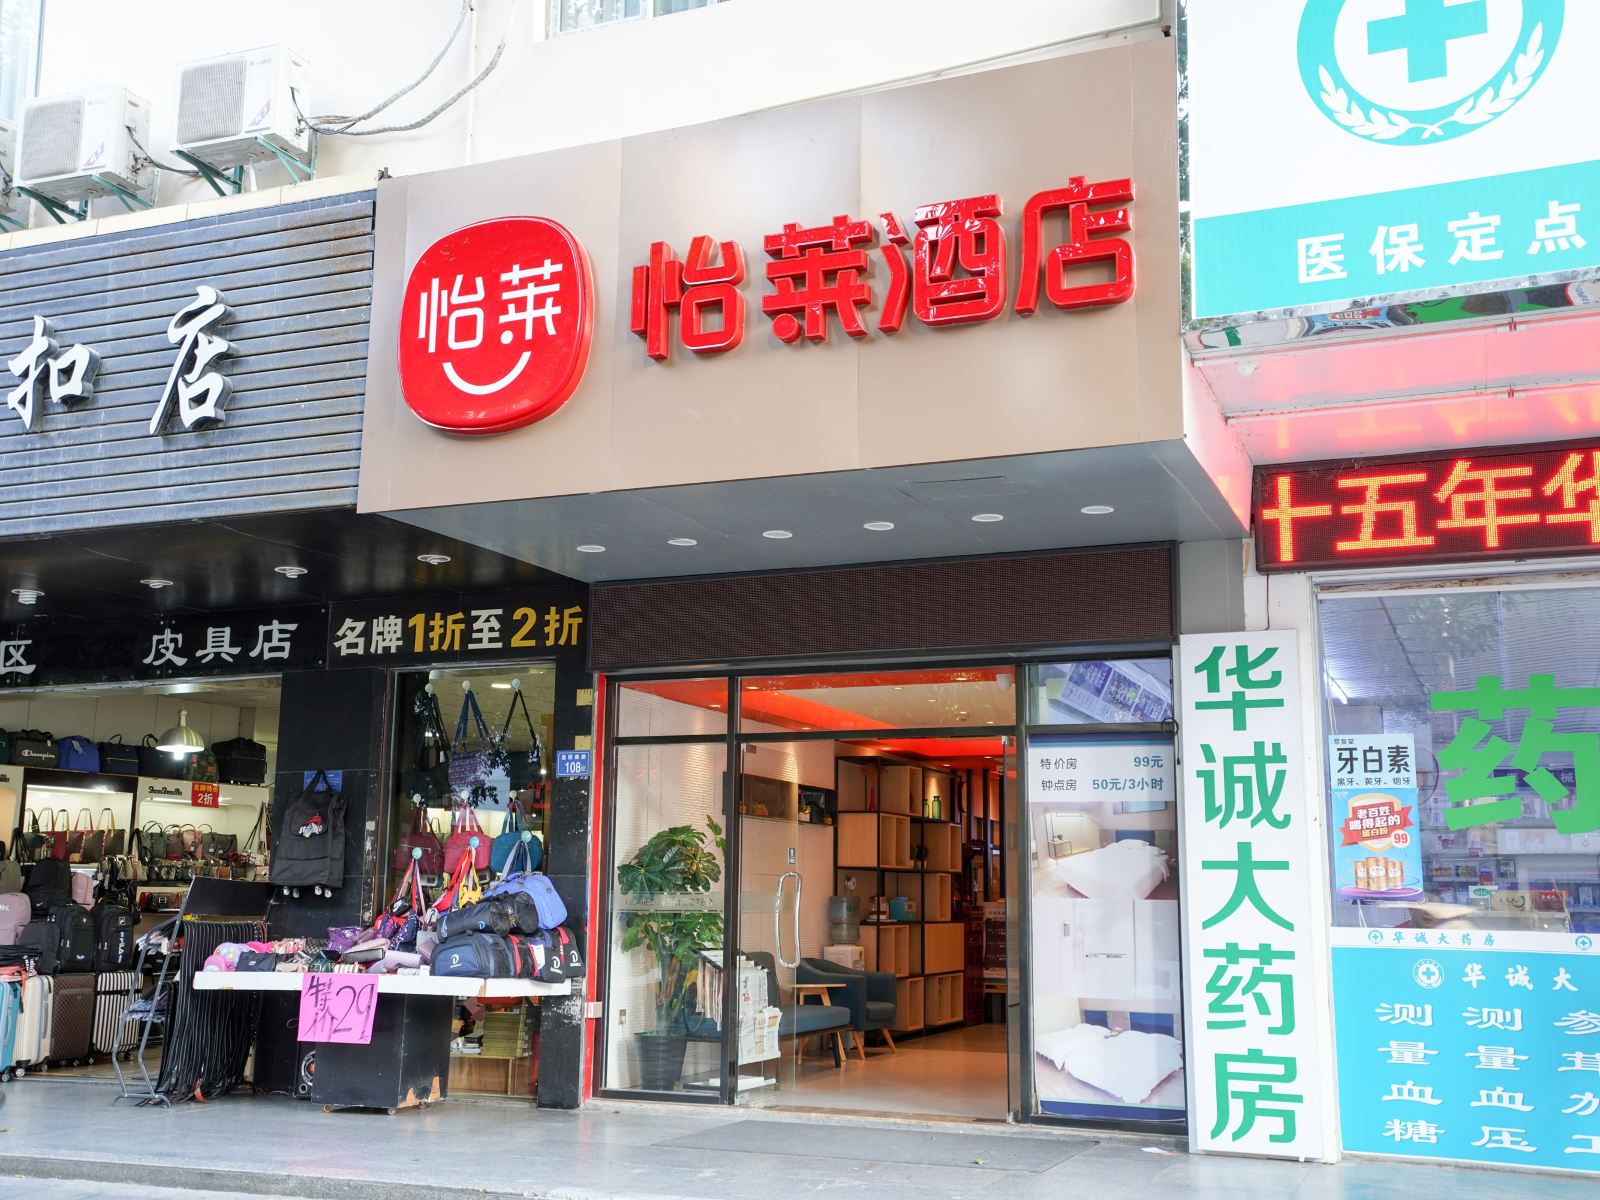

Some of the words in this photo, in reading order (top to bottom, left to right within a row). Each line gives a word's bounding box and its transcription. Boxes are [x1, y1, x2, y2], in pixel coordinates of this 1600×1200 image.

[1296, 199, 1588, 285] 医保定点
[630, 175, 1136, 361] 怡莱酒店
[418, 258, 563, 353] 怡莱
[7, 285, 238, 436] 扣店
[142, 619, 298, 667] 皮具店
[333, 605, 584, 656] 名牌1折至2折
[1040, 758, 1078, 770] 特价房
[1134, 756, 1164, 768] 99元
[1336, 744, 1410, 775] 牙白素
[1431, 674, 1600, 836] 药
[197, 793, 214, 806] 2折
[1041, 779, 1078, 791] 钟点房
[1092, 778, 1164, 791] 50元/3小时
[1348, 814, 1401, 831] 喝得起的
[1356, 805, 1391, 819] 老百姓
[1393, 833, 1409, 844] 99
[1194, 644, 1304, 1144] 华诚大药房
[1392, 930, 1496, 946] 华诚大药房
[1461, 962, 1579, 992] 华诚大
[1375, 1002, 1446, 1144] 测量血糖
[1461, 1006, 1538, 1153] 测量血压
